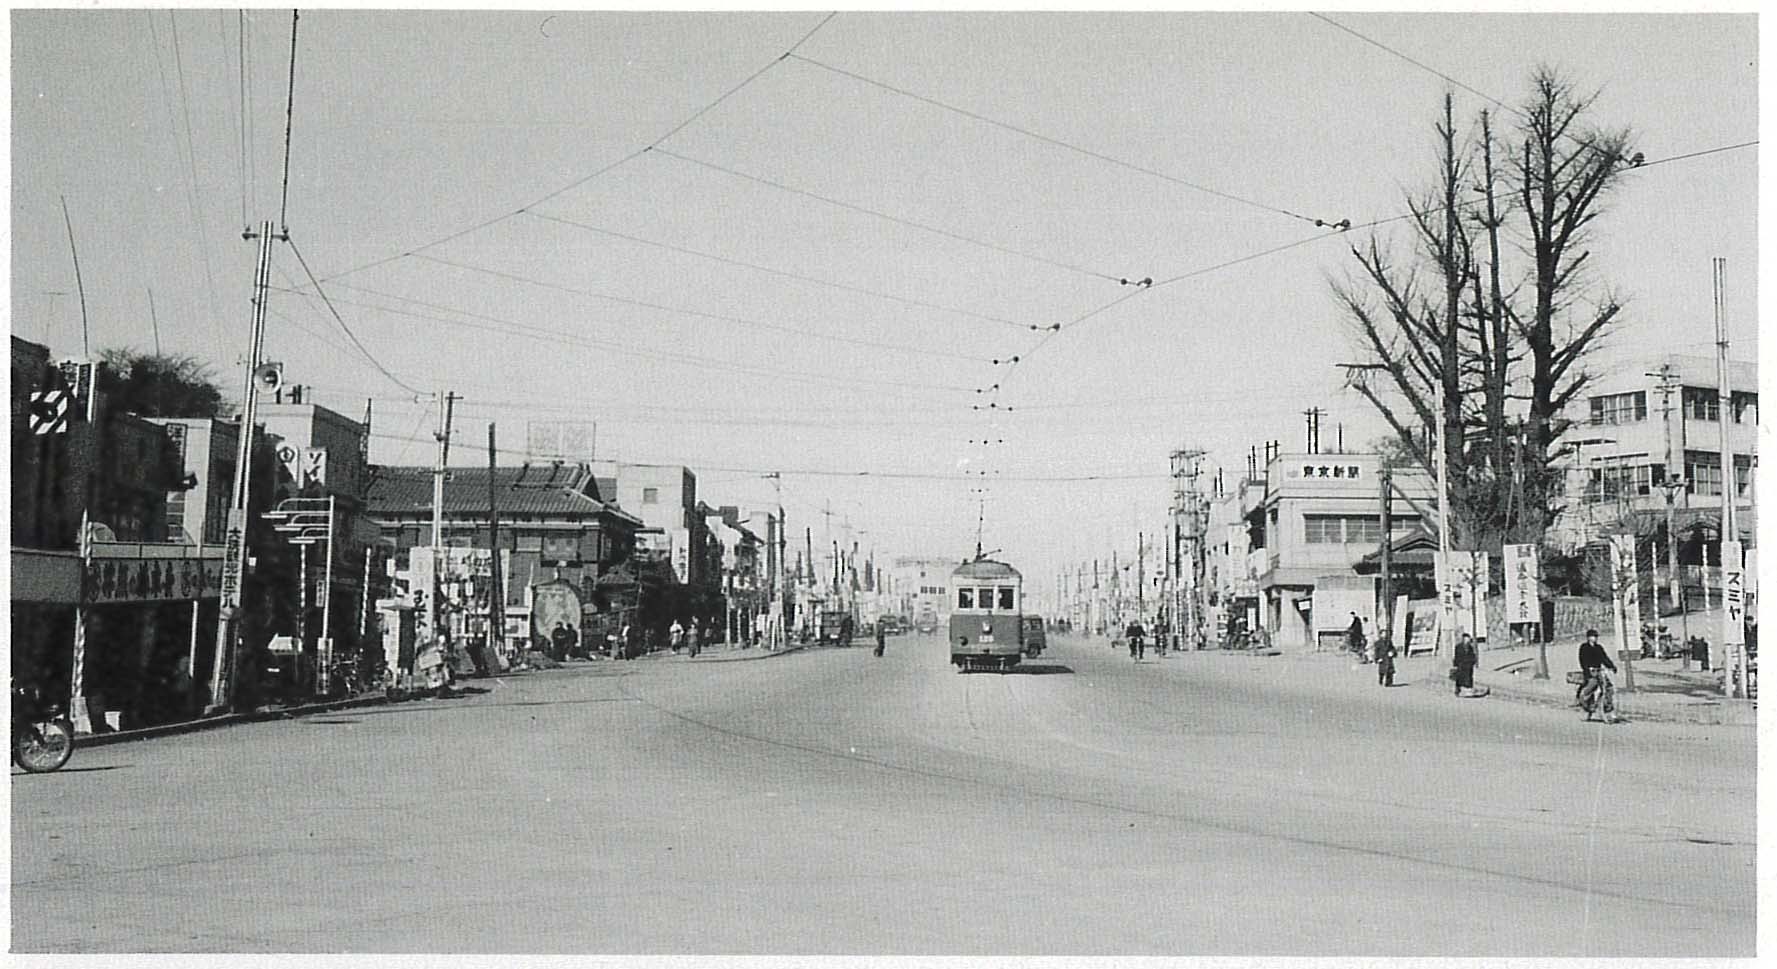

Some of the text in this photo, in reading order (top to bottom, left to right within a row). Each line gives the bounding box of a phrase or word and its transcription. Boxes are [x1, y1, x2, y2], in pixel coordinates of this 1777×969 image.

[1303, 465, 1360, 478] 東京新聞
[1728, 572, 1741, 621] スミヤ
